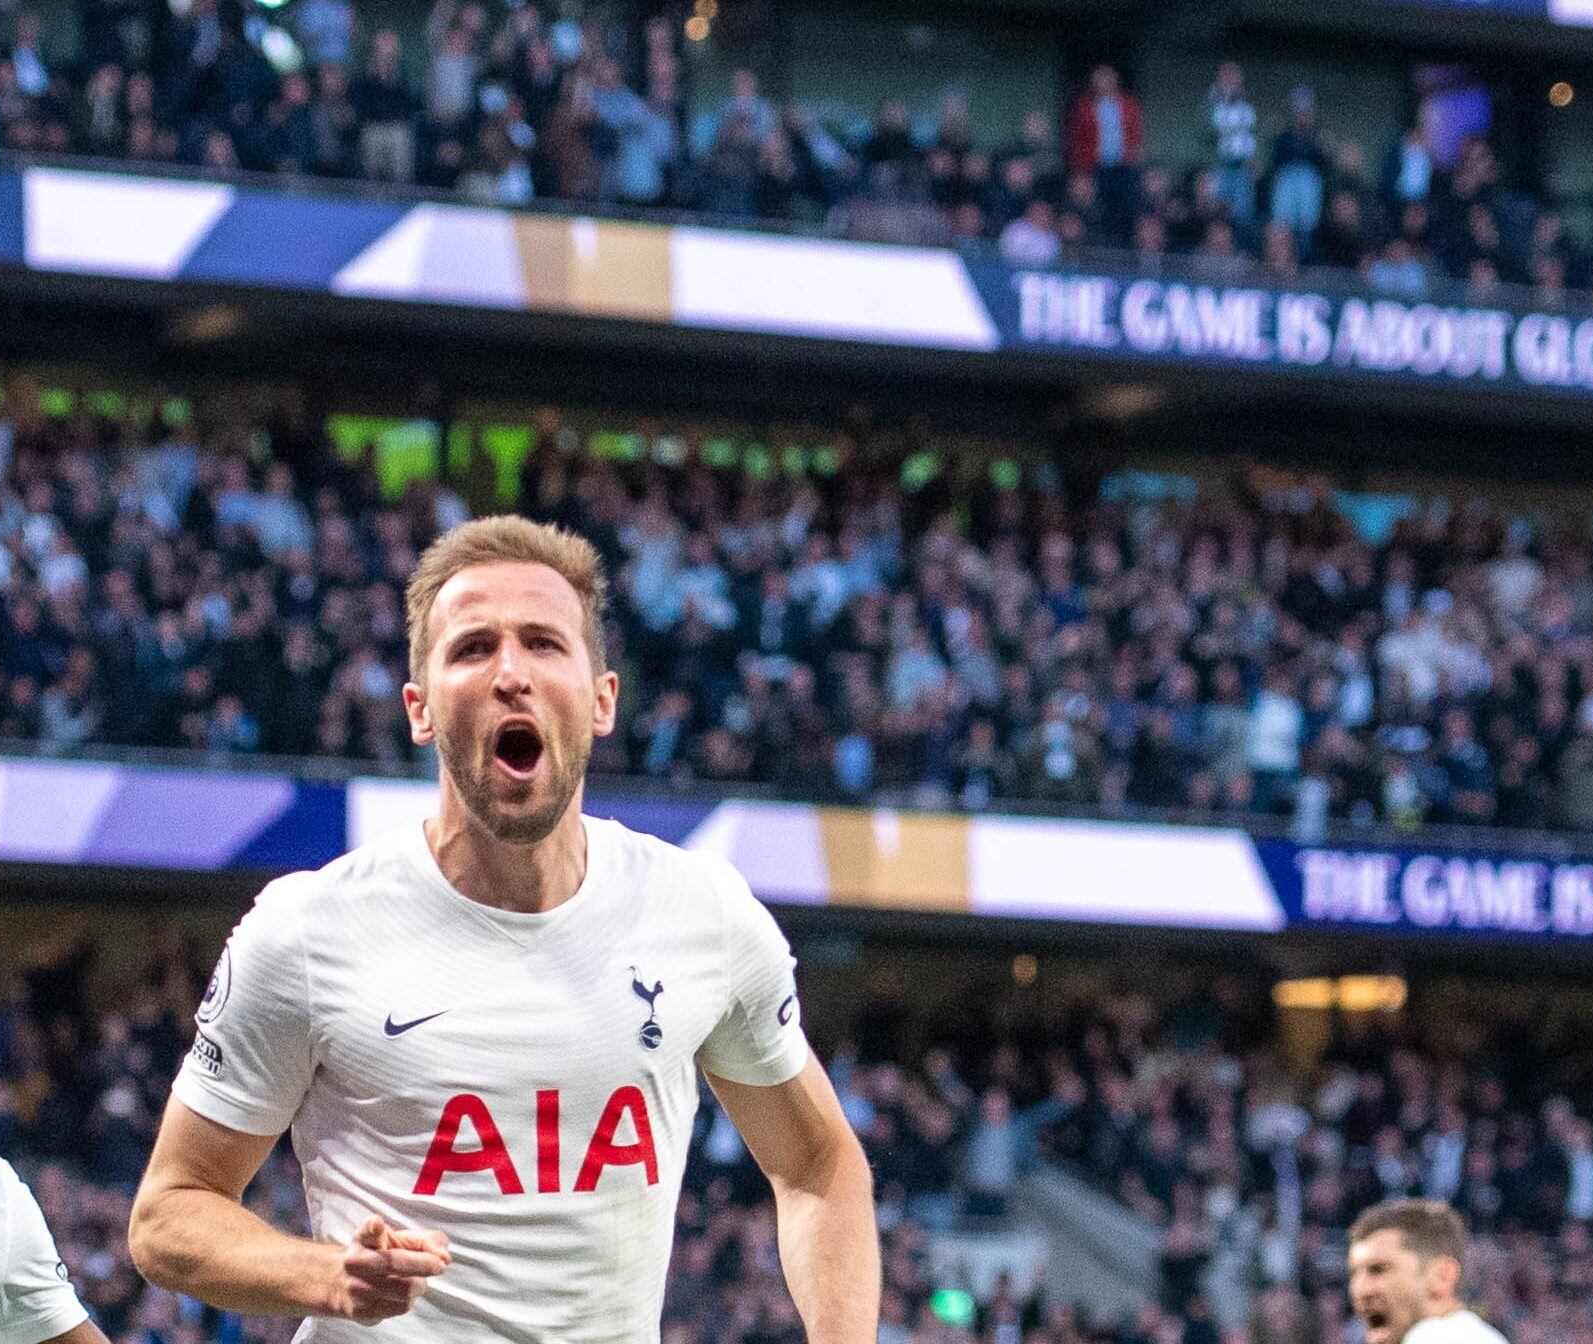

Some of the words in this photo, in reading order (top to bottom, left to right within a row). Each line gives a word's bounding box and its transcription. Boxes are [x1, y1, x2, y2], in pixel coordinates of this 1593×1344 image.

[1013, 271, 1119, 348] THE
[1120, 280, 1273, 361] GAME
[1276, 292, 1330, 366] IS
[1332, 298, 1512, 380] ABOUT
[1297, 849, 1401, 923] THE
[1402, 854, 1549, 933] GAME
[413, 1086, 659, 1195] AIA
